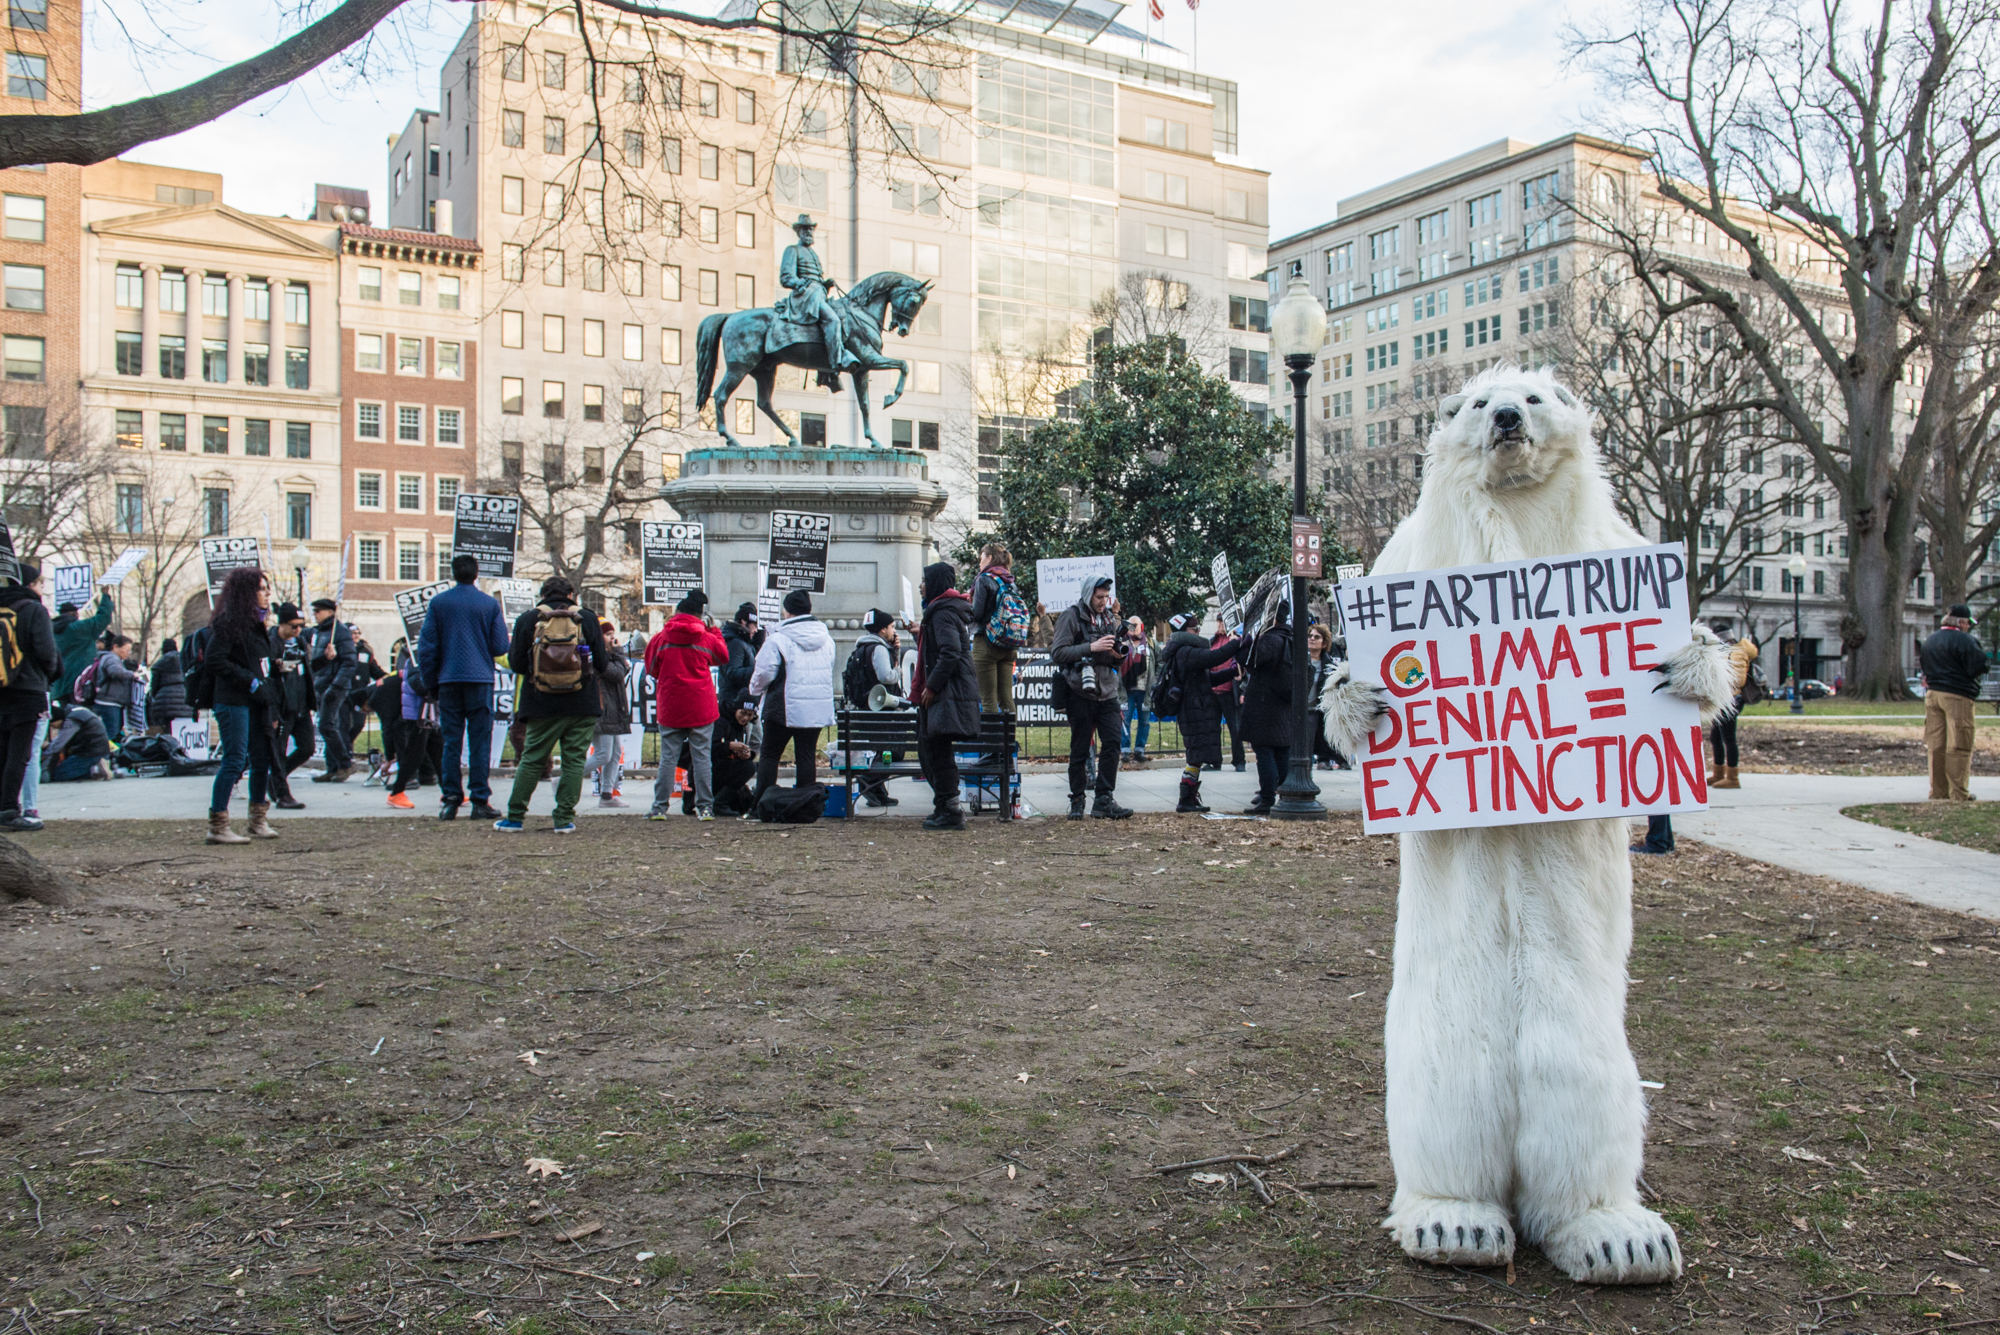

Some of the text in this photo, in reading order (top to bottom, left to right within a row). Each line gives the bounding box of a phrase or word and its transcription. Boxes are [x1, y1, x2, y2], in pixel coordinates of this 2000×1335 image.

[458, 496, 517, 513] STOP
[773, 513, 829, 530] STOP
[644, 523, 701, 539] STOP
[203, 538, 257, 553] STOP
[1086, 560, 1106, 573] rights
[1339, 566, 1362, 580] STOP
[56, 566, 90, 591] NO!
[501, 580, 530, 591] STOP
[686, 581, 703, 589] HALT!
[397, 583, 450, 607] STOP
[655, 590, 668, 598] NO!
[1348, 553, 1684, 632] #EARTH2TRUMP
[1380, 618, 1663, 698] CLIMATE
[1026, 683, 1053, 700] ACC
[1367, 683, 1627, 756] DENIAL =
[1362, 725, 1708, 822] EXTINCTION
